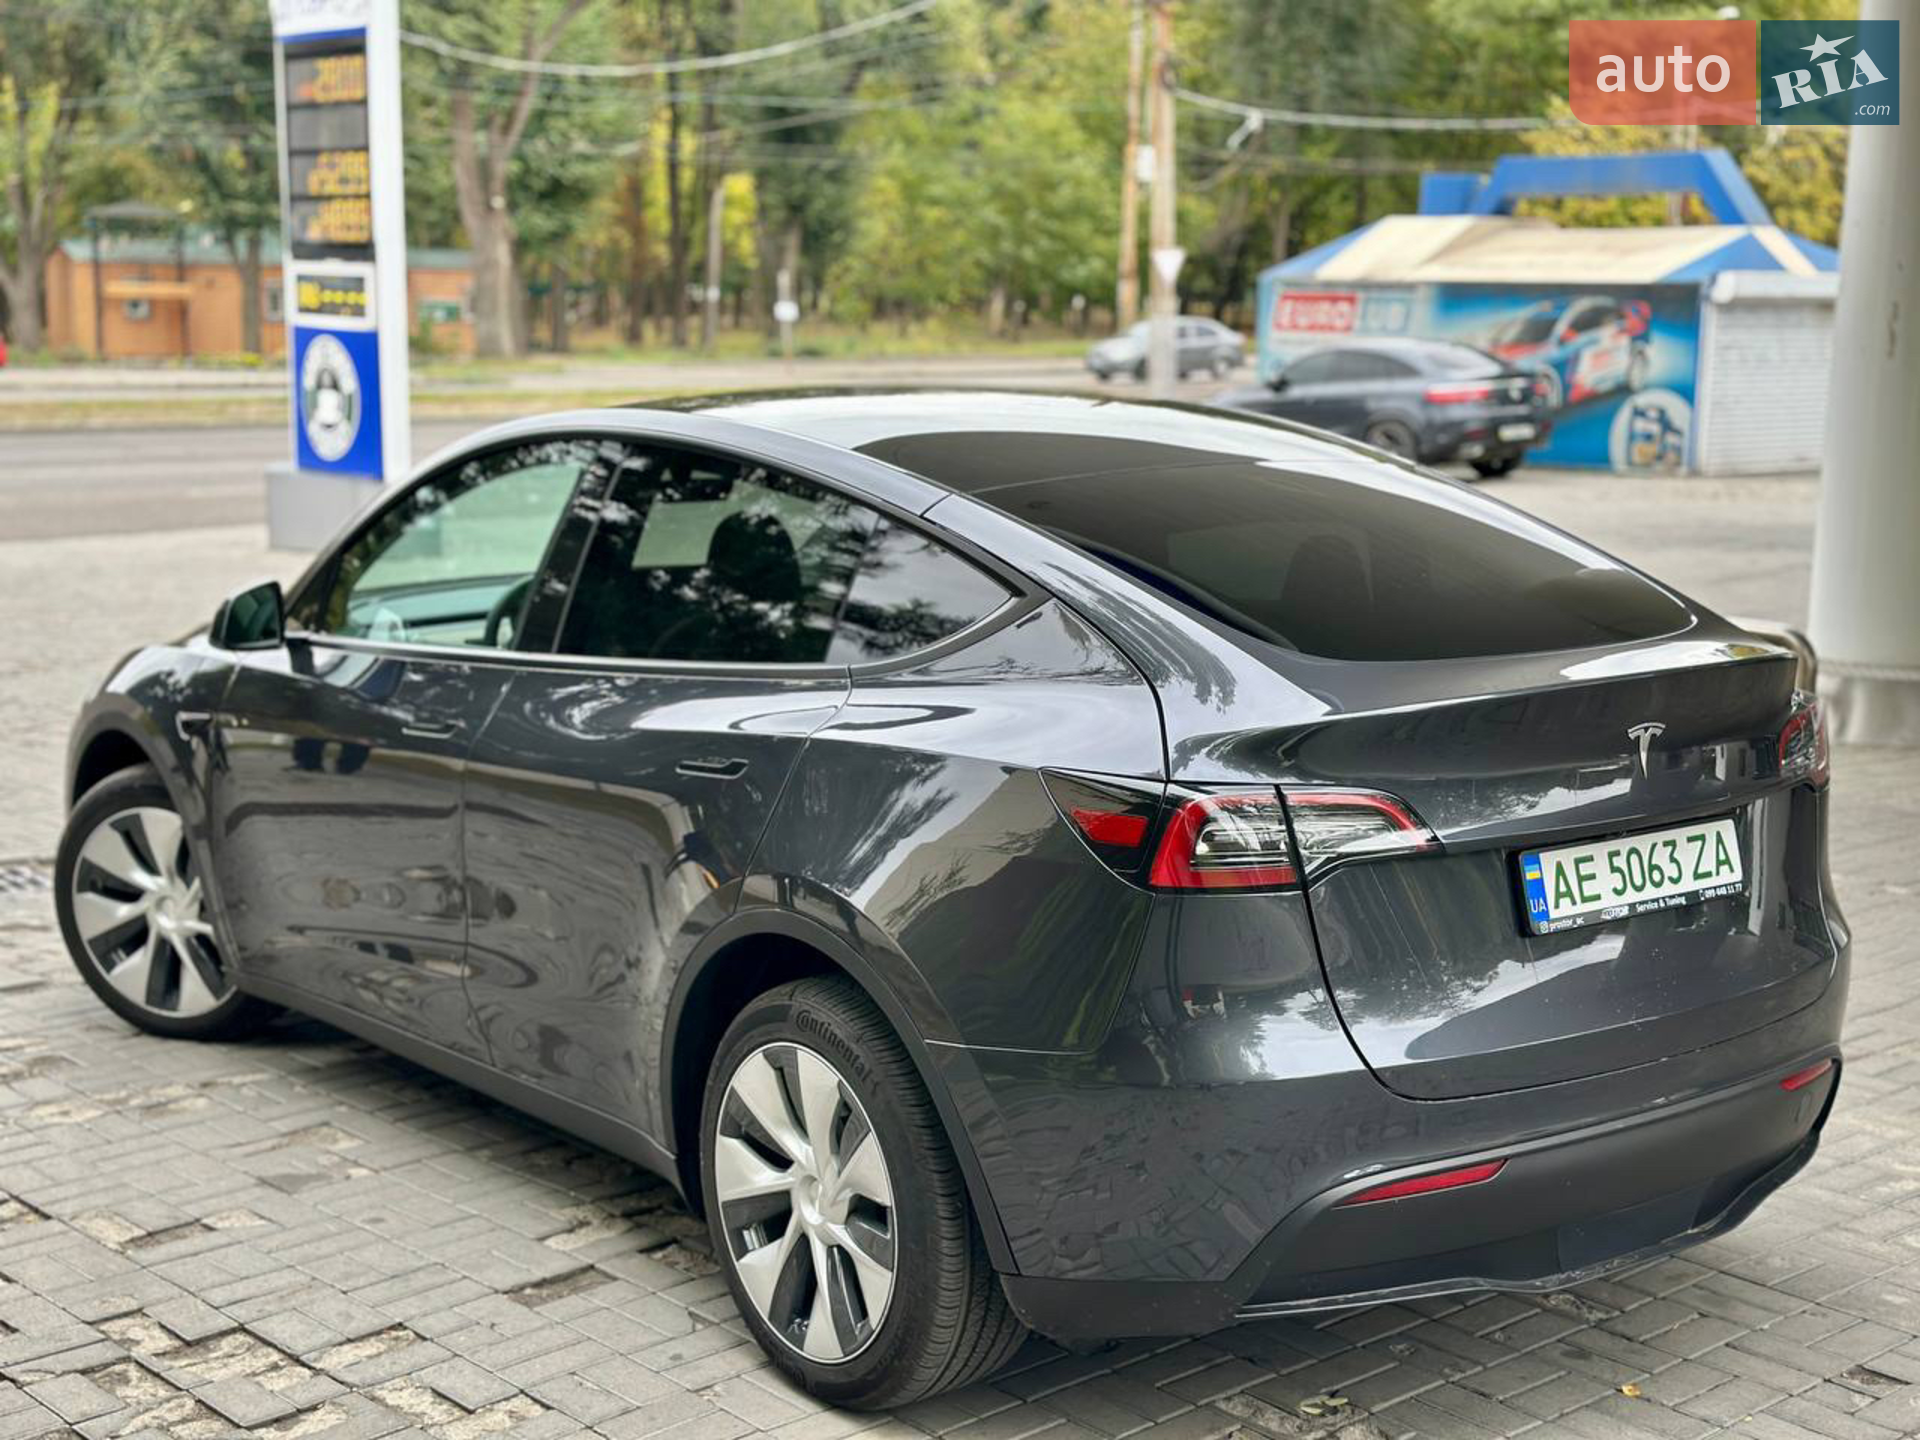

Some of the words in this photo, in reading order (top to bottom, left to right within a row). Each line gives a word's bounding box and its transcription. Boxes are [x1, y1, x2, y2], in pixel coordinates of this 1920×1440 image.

[1530, 898, 1547, 912] UA
[1554, 855, 1601, 909] AE
[1607, 840, 1682, 896] 5063
[1687, 831, 1734, 881] ZA
[796, 1009, 873, 1081] Continental
